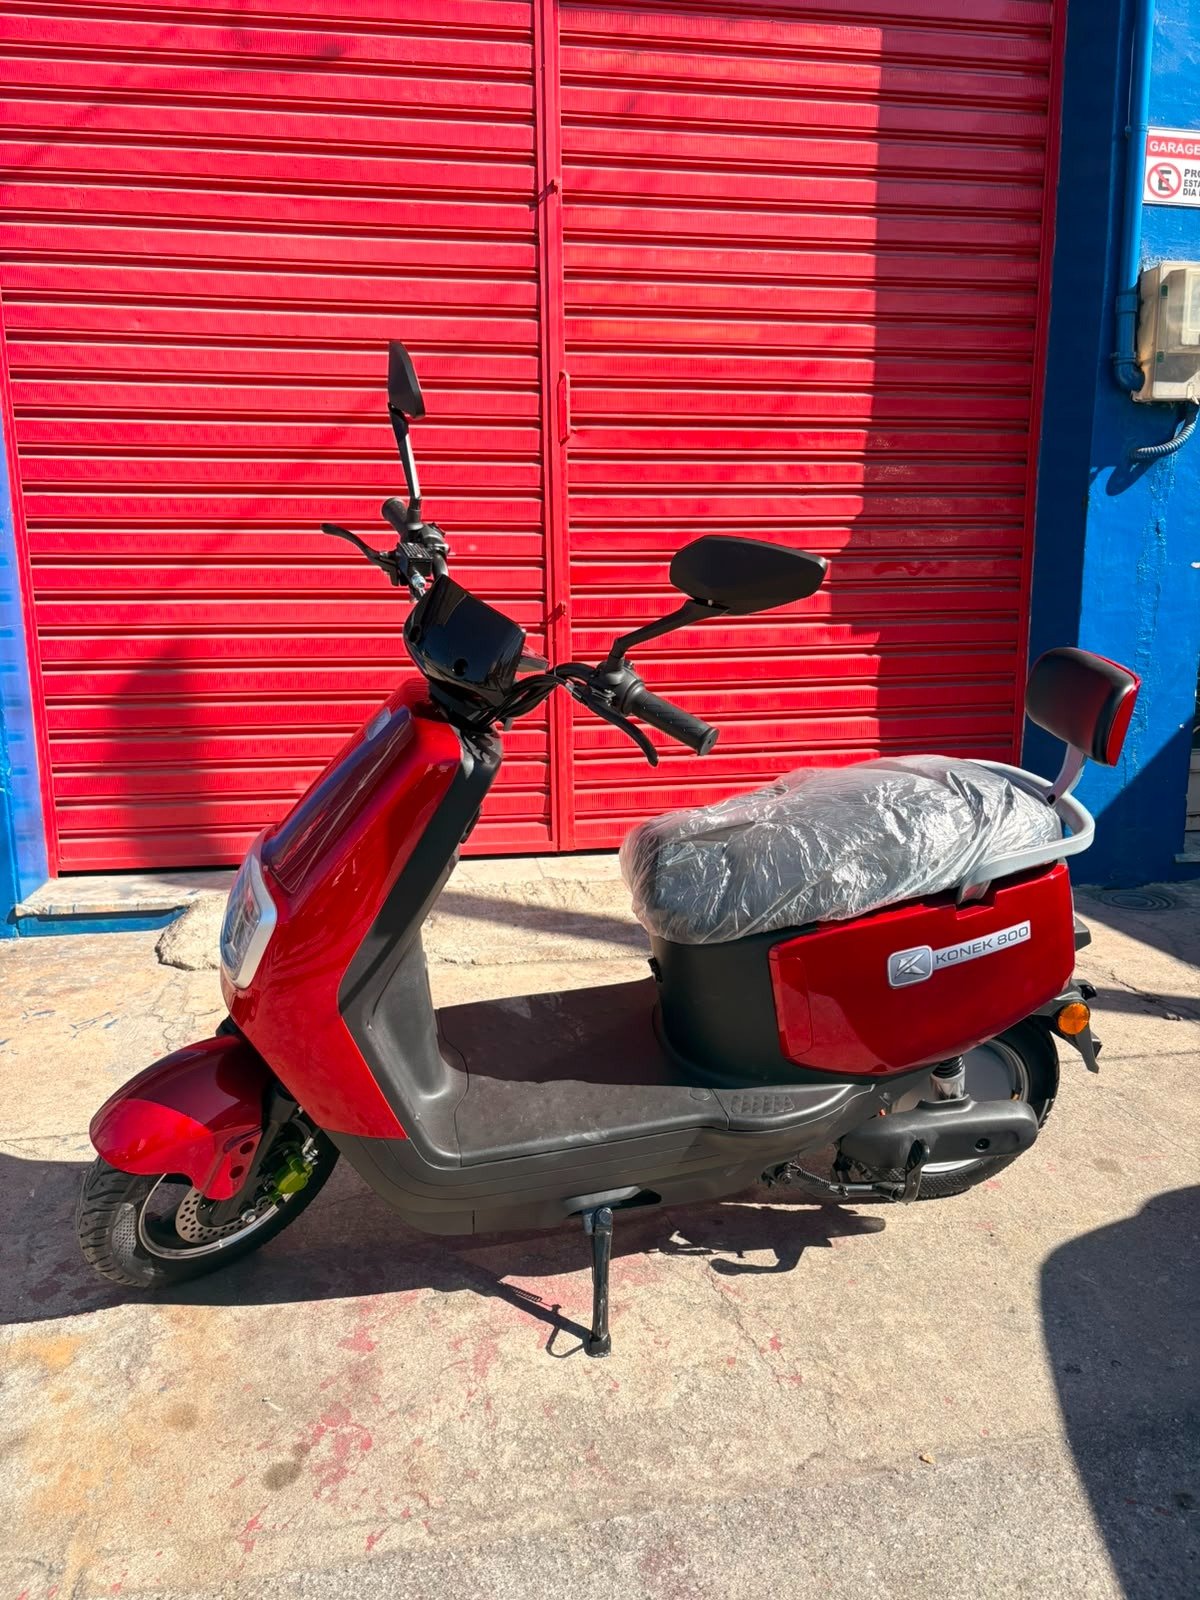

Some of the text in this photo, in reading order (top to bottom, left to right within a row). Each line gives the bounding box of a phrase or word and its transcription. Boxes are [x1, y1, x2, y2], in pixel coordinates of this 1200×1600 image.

[1150, 141, 1200, 155] GARAGE
[1183, 188, 1197, 197] DIA
[936, 938, 993, 964] KONEK
[997, 926, 1029, 946] 800
